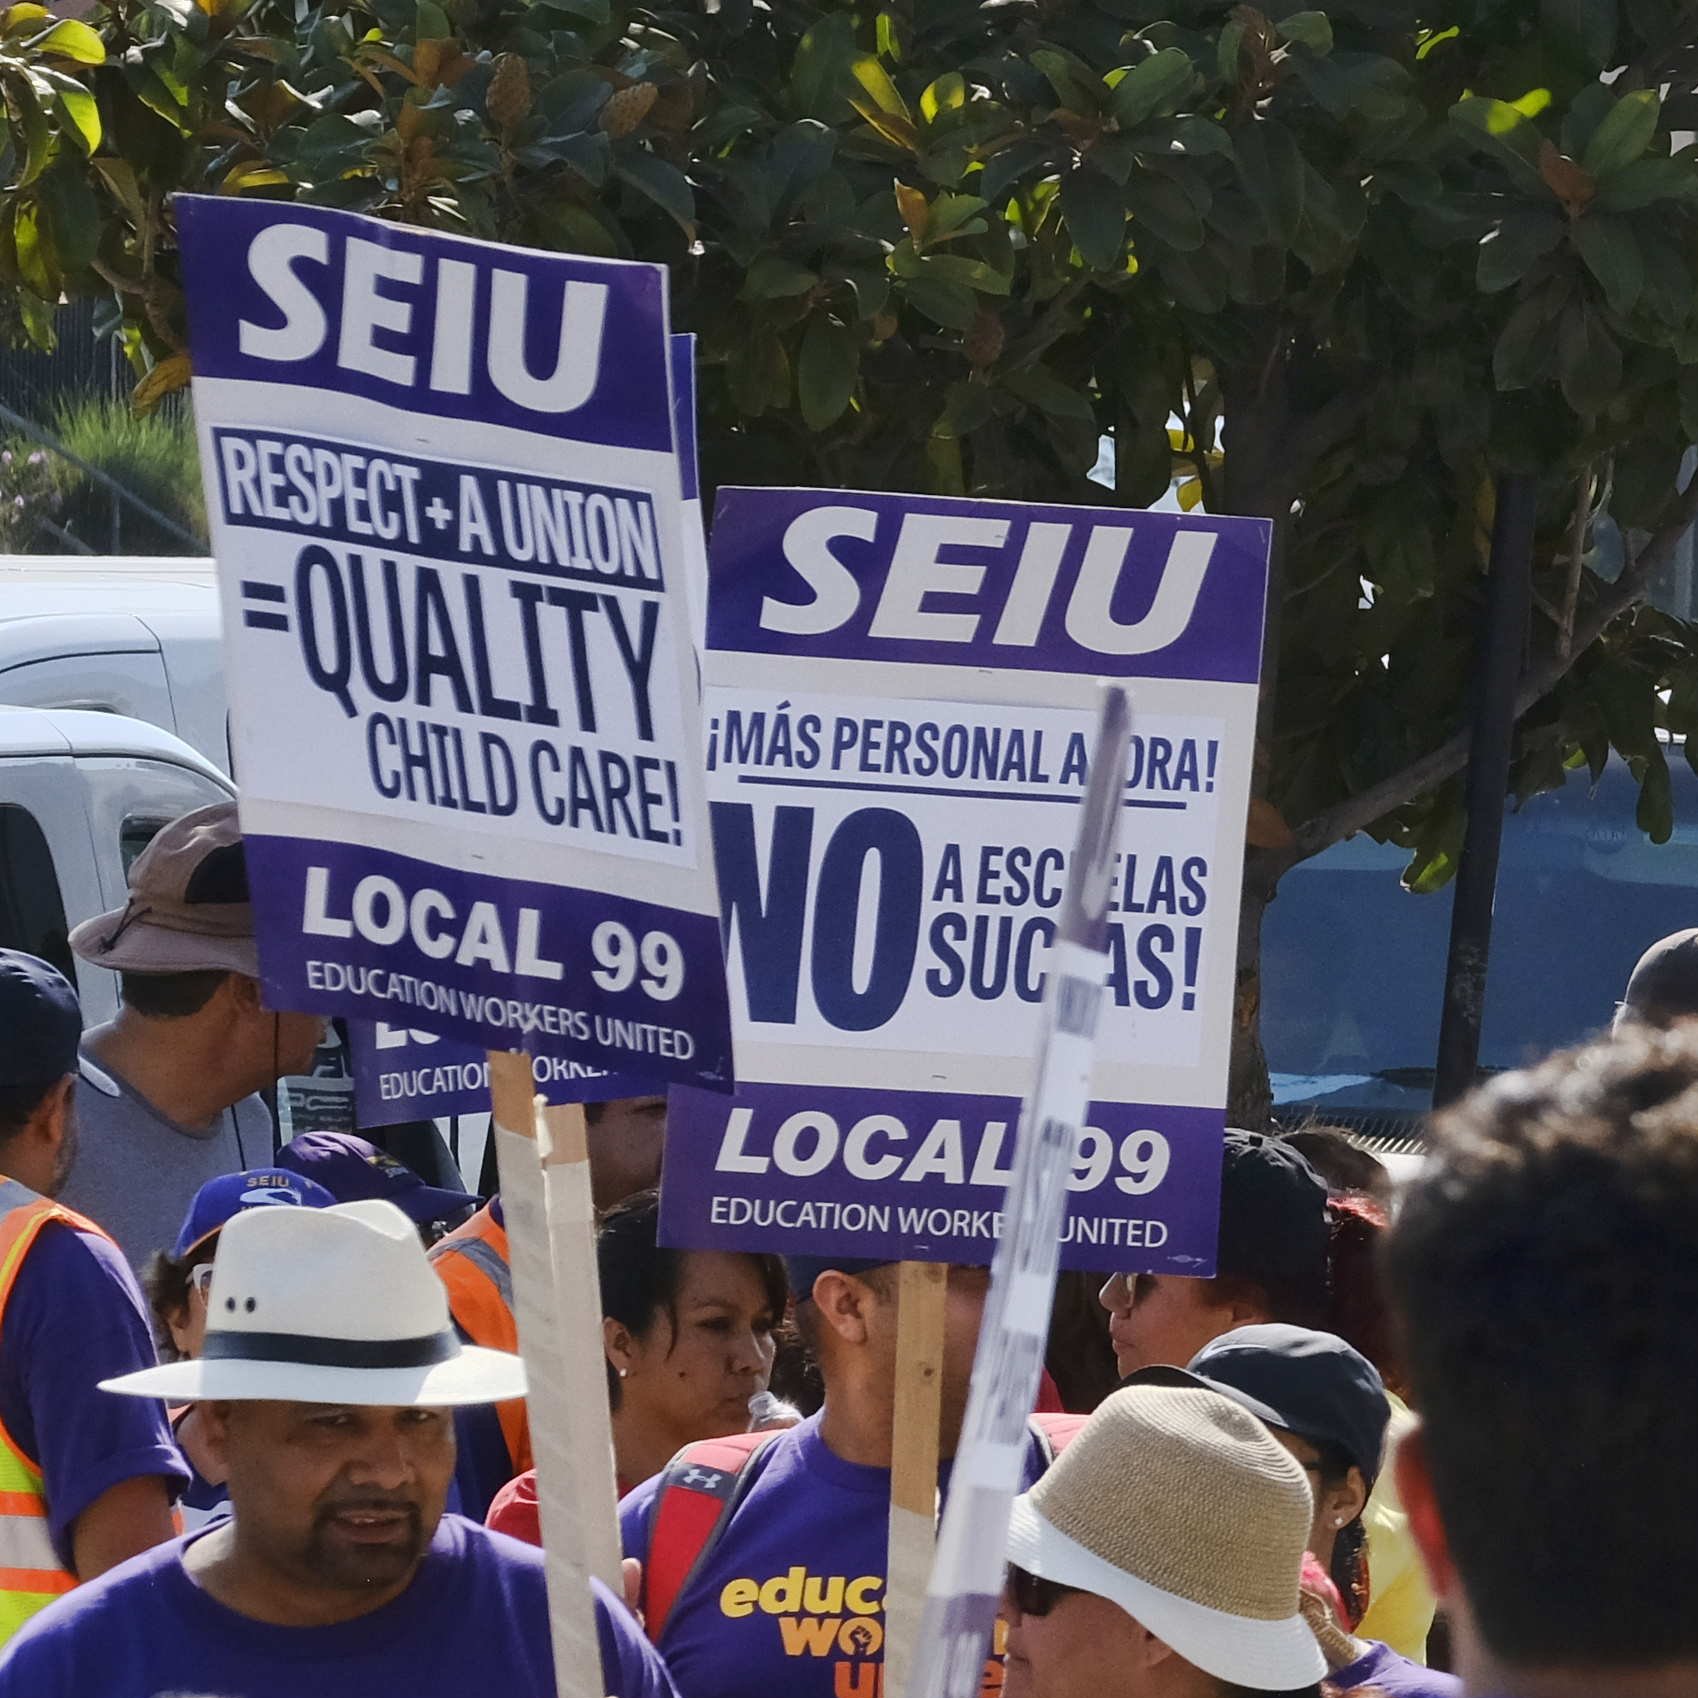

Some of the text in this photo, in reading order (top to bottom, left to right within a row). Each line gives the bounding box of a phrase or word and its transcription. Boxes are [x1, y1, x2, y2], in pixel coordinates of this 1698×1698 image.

[239, 223, 608, 413] SEIU
[220, 436, 659, 580] RESPECT A UNION
[759, 506, 1218, 655] SEIU
[367, 712, 682, 846] CHILD CARE!
[706, 700, 1219, 793] ¡MÁS PERSONAL AORA!
[709, 800, 923, 1032] NO
[932, 844, 1208, 916] A ESCELAS
[303, 867, 685, 1000] LOCAL 99
[926, 912, 1202, 1011] SUCAS!
[307, 960, 458, 1017] EDUCATION
[460, 995, 590, 1041] WORKERS
[596, 1018, 694, 1060] UNITED
[247, 1175, 289, 1187] SEIU
[714, 1107, 1171, 1195] LOCAL 99
[710, 1197, 1168, 1248] EDUCATION UNITED
